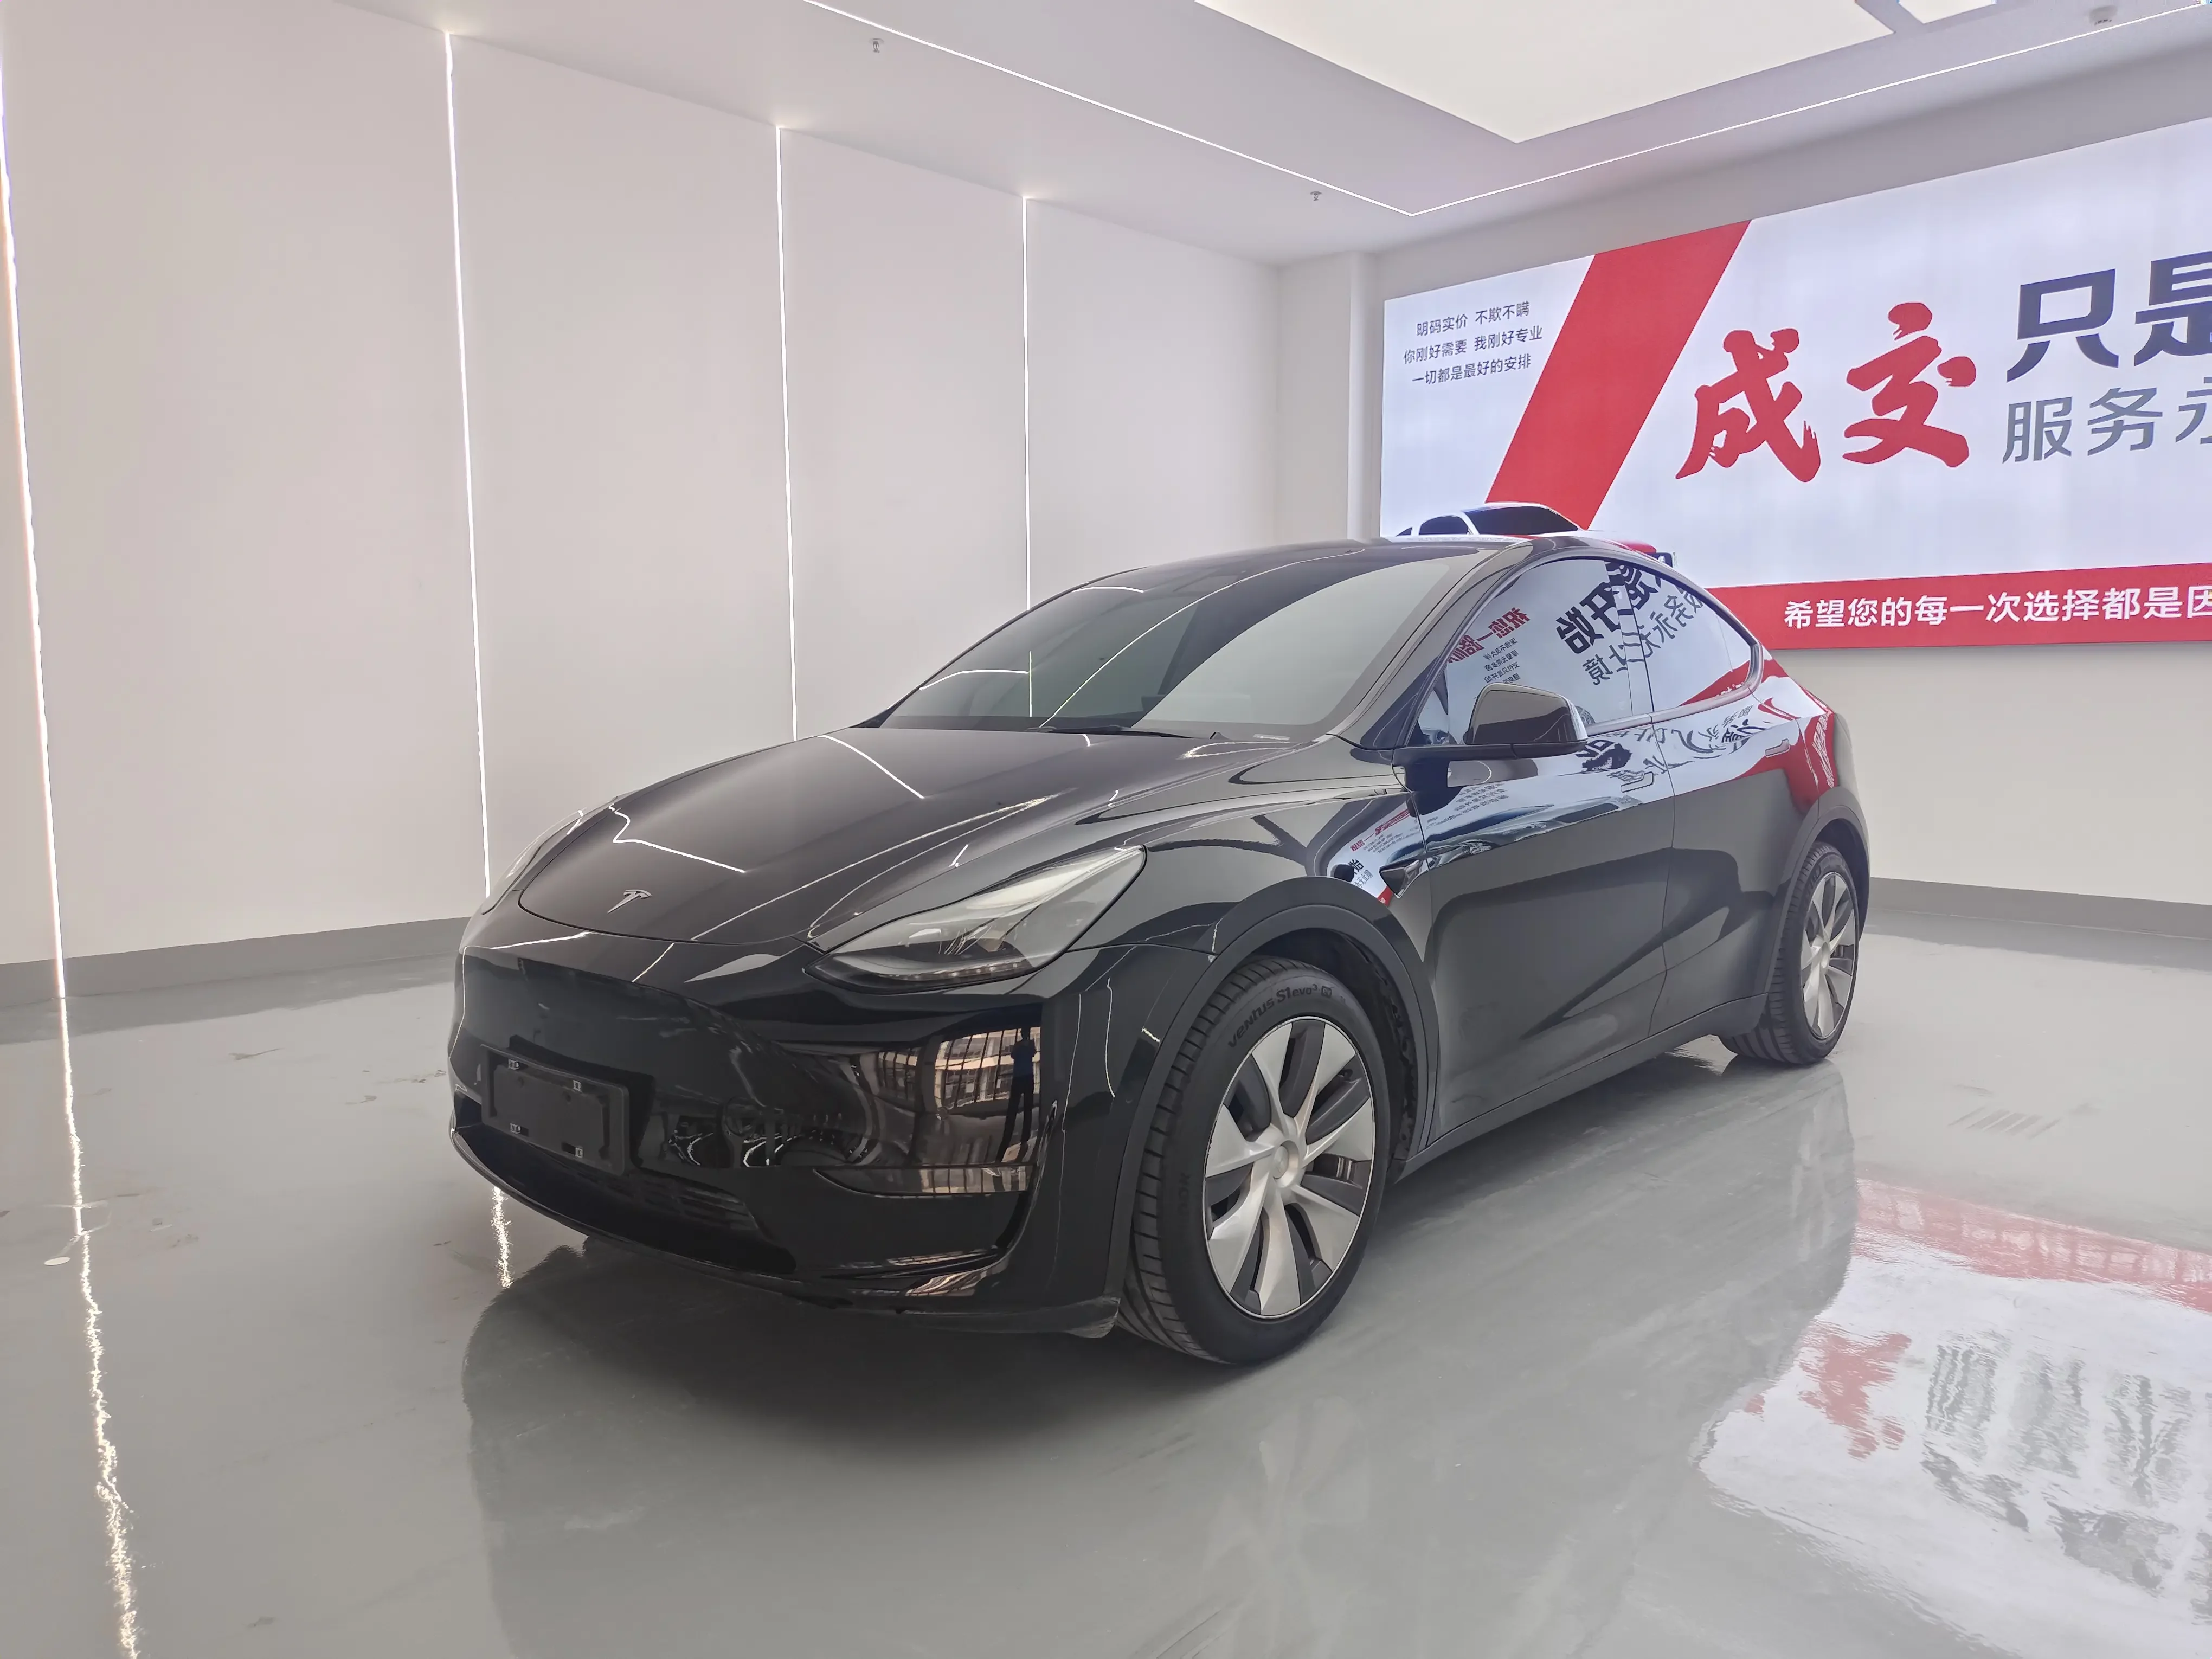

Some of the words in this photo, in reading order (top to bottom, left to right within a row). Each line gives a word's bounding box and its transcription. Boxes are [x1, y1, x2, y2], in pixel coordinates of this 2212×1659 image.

[1416, 313, 1468, 337] 明码实价
[1475, 300, 1530, 325] 不欺不瞒
[2006, 250, 2212, 383] 只是
[1403, 338, 1467, 364] 你刚好需要
[1474, 325, 1542, 351] 我刚好专业
[1412, 353, 1532, 385] 一切都是最好的安排
[1675, 301, 1977, 482] 成交
[1784, 585, 2212, 629] 希望您的每一次选择都是因
